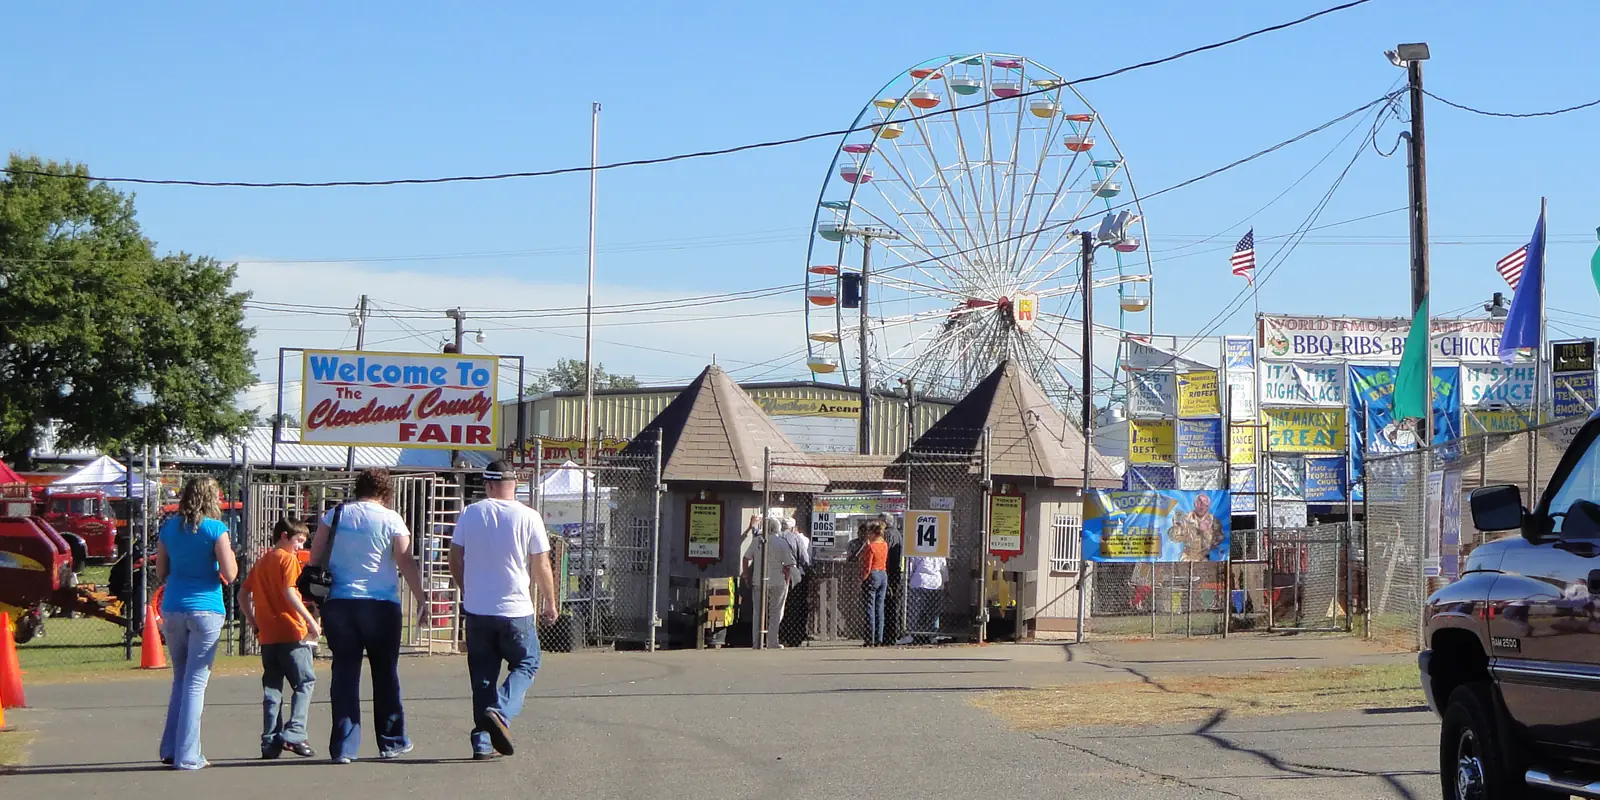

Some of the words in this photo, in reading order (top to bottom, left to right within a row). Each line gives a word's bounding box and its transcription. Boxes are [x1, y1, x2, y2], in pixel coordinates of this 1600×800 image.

[1273, 319, 1329, 331] WORLD
[1331, 320, 1398, 332] FAMOUS
[1293, 334, 1333, 356] BBQ
[1341, 335, 1383, 355] RIBS
[1440, 336, 1502, 356] CHICKE
[310, 356, 448, 386] Welcome
[456, 361, 490, 387] To
[1304, 368, 1338, 383] THE
[1467, 367, 1499, 382] IT'S
[1503, 367, 1536, 381] THE
[1555, 376, 1593, 388] SWEET
[336, 387, 362, 399] The
[1265, 382, 1301, 399] RIGHT
[1305, 384, 1341, 401] LACE
[1471, 383, 1534, 400] SAUCE
[306, 393, 415, 431] Cleveland
[415, 387, 493, 422] County
[818, 403, 860, 412] Arena
[1491, 414, 1520, 431] MAKES
[399, 423, 492, 444] FAIR
[1271, 429, 1339, 446] GREAT
[527, 447, 567, 460] CNDY
[818, 513, 829, 521] NO
[813, 522, 834, 530] DOGS
[917, 525, 937, 546] 14
[1491, 637, 1502, 646] RAM
[1502, 638, 1517, 647] 2500
